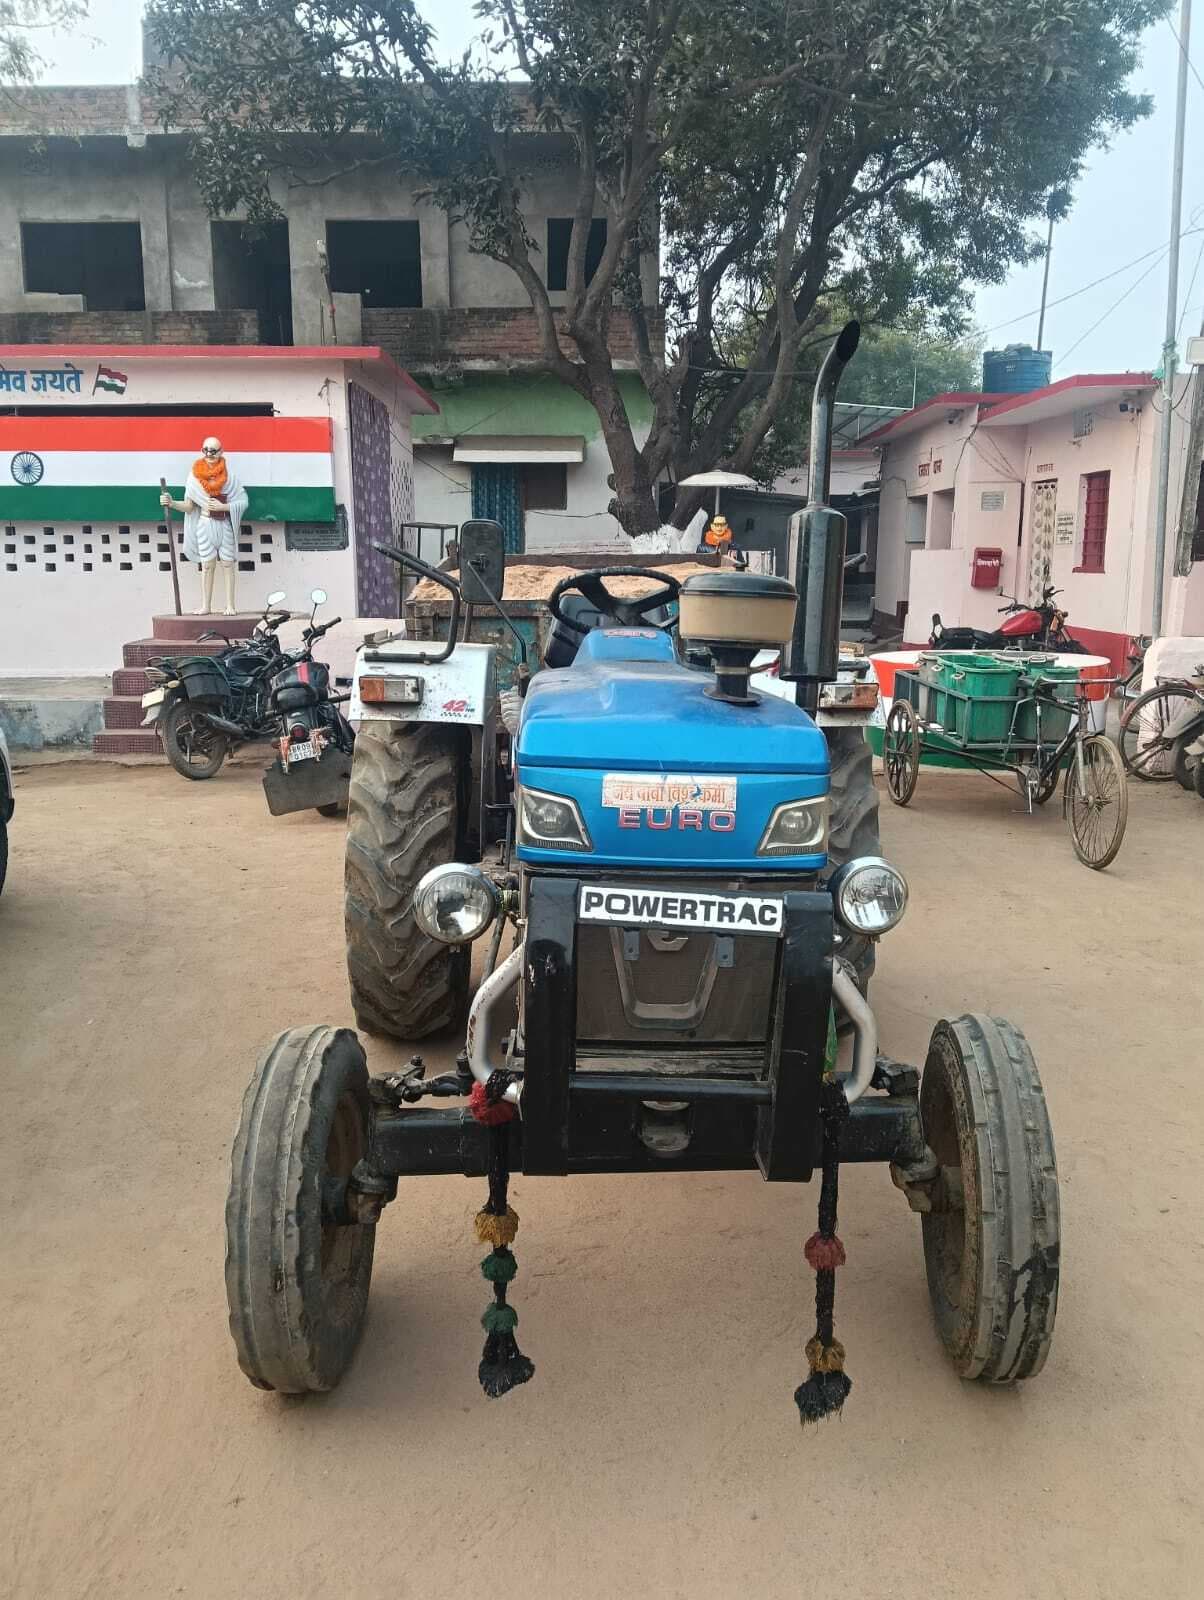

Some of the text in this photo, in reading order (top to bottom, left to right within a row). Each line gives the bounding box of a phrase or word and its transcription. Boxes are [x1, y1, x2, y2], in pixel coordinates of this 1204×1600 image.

[30, 362, 84, 393] जयते
[442, 700, 467, 712] 42
[619, 808, 736, 832] EURO
[584, 891, 778, 927] POWERTRAC
